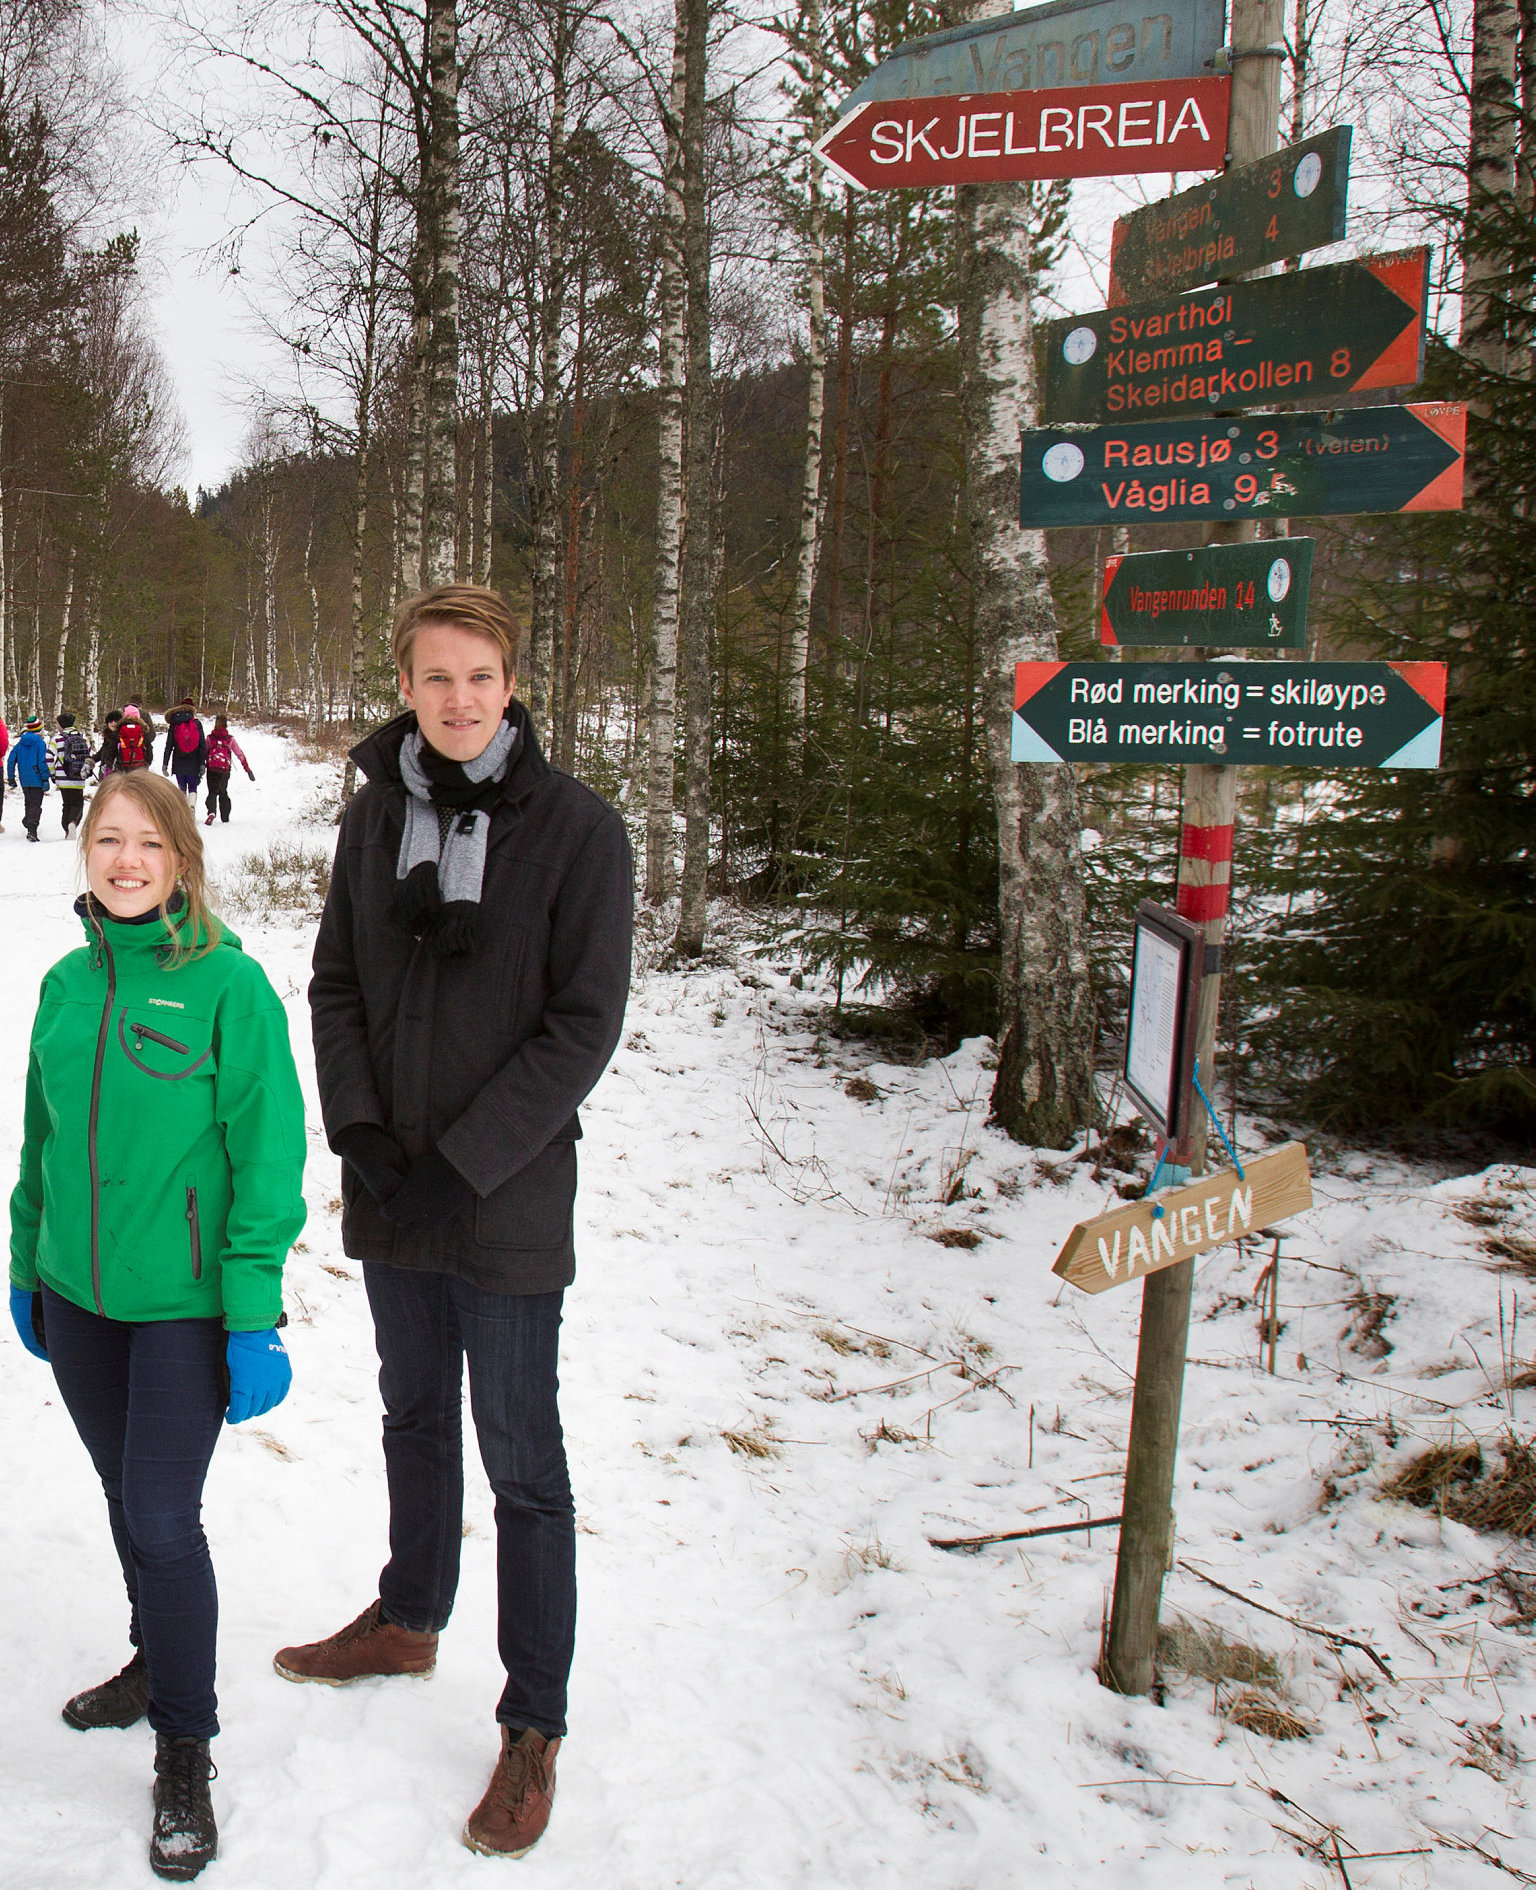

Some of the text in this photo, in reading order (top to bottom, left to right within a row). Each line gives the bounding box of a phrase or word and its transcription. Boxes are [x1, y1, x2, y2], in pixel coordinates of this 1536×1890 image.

[970, 13, 1172, 91] Vangen
[870, 98, 1210, 164] SKJELBREIA
[1268, 169, 1282, 199] 3
[1266, 214, 1279, 241] 4
[1109, 295, 1233, 345] Svarthol
[1107, 349, 1352, 411] Skeidarkollen 8
[1104, 434, 1232, 474] Rausjø
[1255, 430, 1279, 461] 3
[1102, 477, 1211, 513] Våglia
[1130, 581, 1255, 618] Vangenrunden 14
[1071, 677, 1123, 705] Rød
[1133, 678, 1239, 708] merking
[1270, 678, 1386, 710] skiløype
[1069, 718, 1108, 744] Blå
[1119, 720, 1225, 750] merking
[1268, 720, 1363, 748] fotrute
[1099, 1185, 1252, 1279] VANGEN
